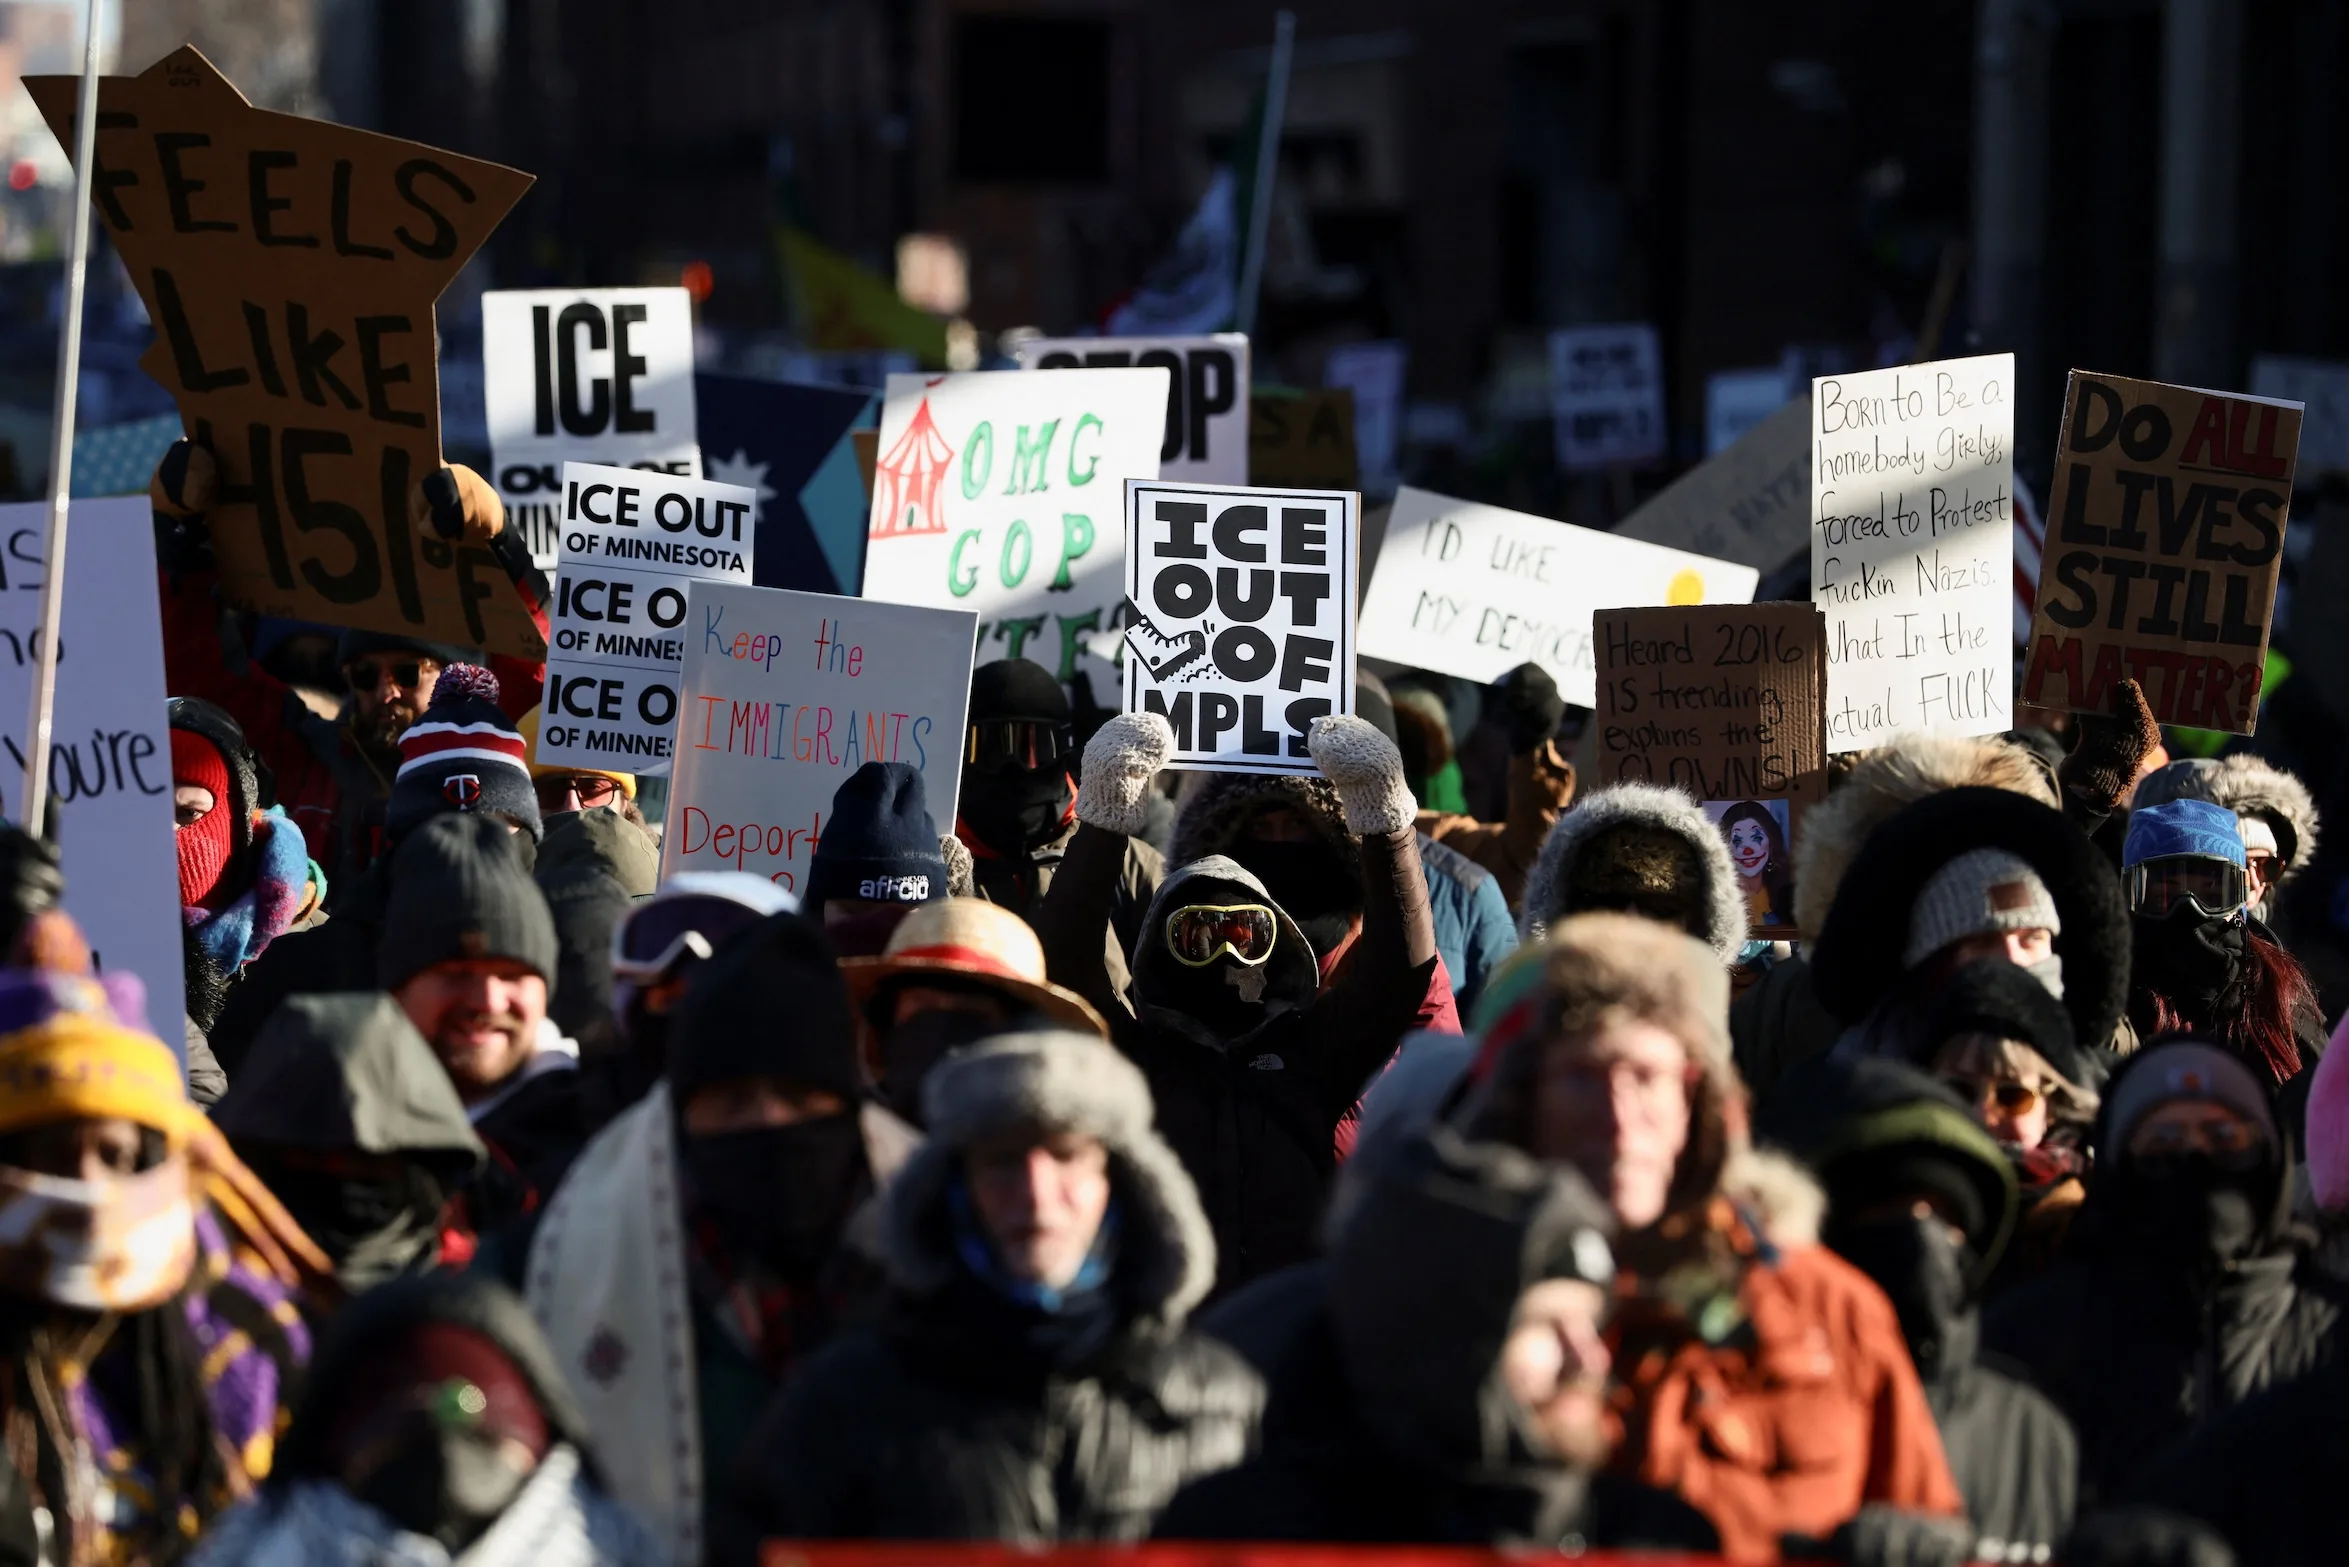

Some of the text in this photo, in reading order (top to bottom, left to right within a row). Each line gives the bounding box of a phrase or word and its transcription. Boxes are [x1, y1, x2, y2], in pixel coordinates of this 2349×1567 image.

[70, 112, 476, 259] FEELS
[152, 268, 425, 428] LIKE
[532, 299, 654, 437] ICE
[1890, 374, 1923, 422] to
[1937, 372, 1974, 417] Be
[1982, 380, 2003, 405] a
[961, 412, 1104, 500] OMG
[1818, 435, 1925, 484] homebody
[2178, 396, 2288, 478] ALL
[567, 481, 640, 528] ICE
[654, 492, 750, 543] OUT
[1154, 500, 1327, 566] ICE
[1816, 484, 2008, 549] forced to Protest
[2060, 463, 2287, 567] LIVES
[566, 532, 746, 574] OF MINNESOTA
[948, 512, 1096, 597] GOP
[1490, 534, 1558, 585] LIKE
[557, 577, 634, 624] ICE
[1152, 563, 1330, 627] OUT
[1411, 590, 1468, 634] MY
[2043, 551, 2263, 648] STILL
[556, 629, 590, 651] OF
[704, 605, 863, 677] Keep the
[1211, 625, 1334, 693] OF
[1605, 621, 1803, 669] Heard 2016
[1893, 612, 1927, 660] In
[1938, 611, 1988, 655] the
[548, 673, 624, 721] ICE
[1650, 671, 1784, 725] trending
[1918, 667, 2004, 727] FUCK
[2025, 634, 2263, 731] MATTER?
[546, 725, 673, 758] OF MINNE
[694, 695, 932, 772] IMMIGRANTS
[1144, 689, 1332, 758] MPLS
[1719, 721, 1775, 746] the
[682, 806, 820, 872] Deport
